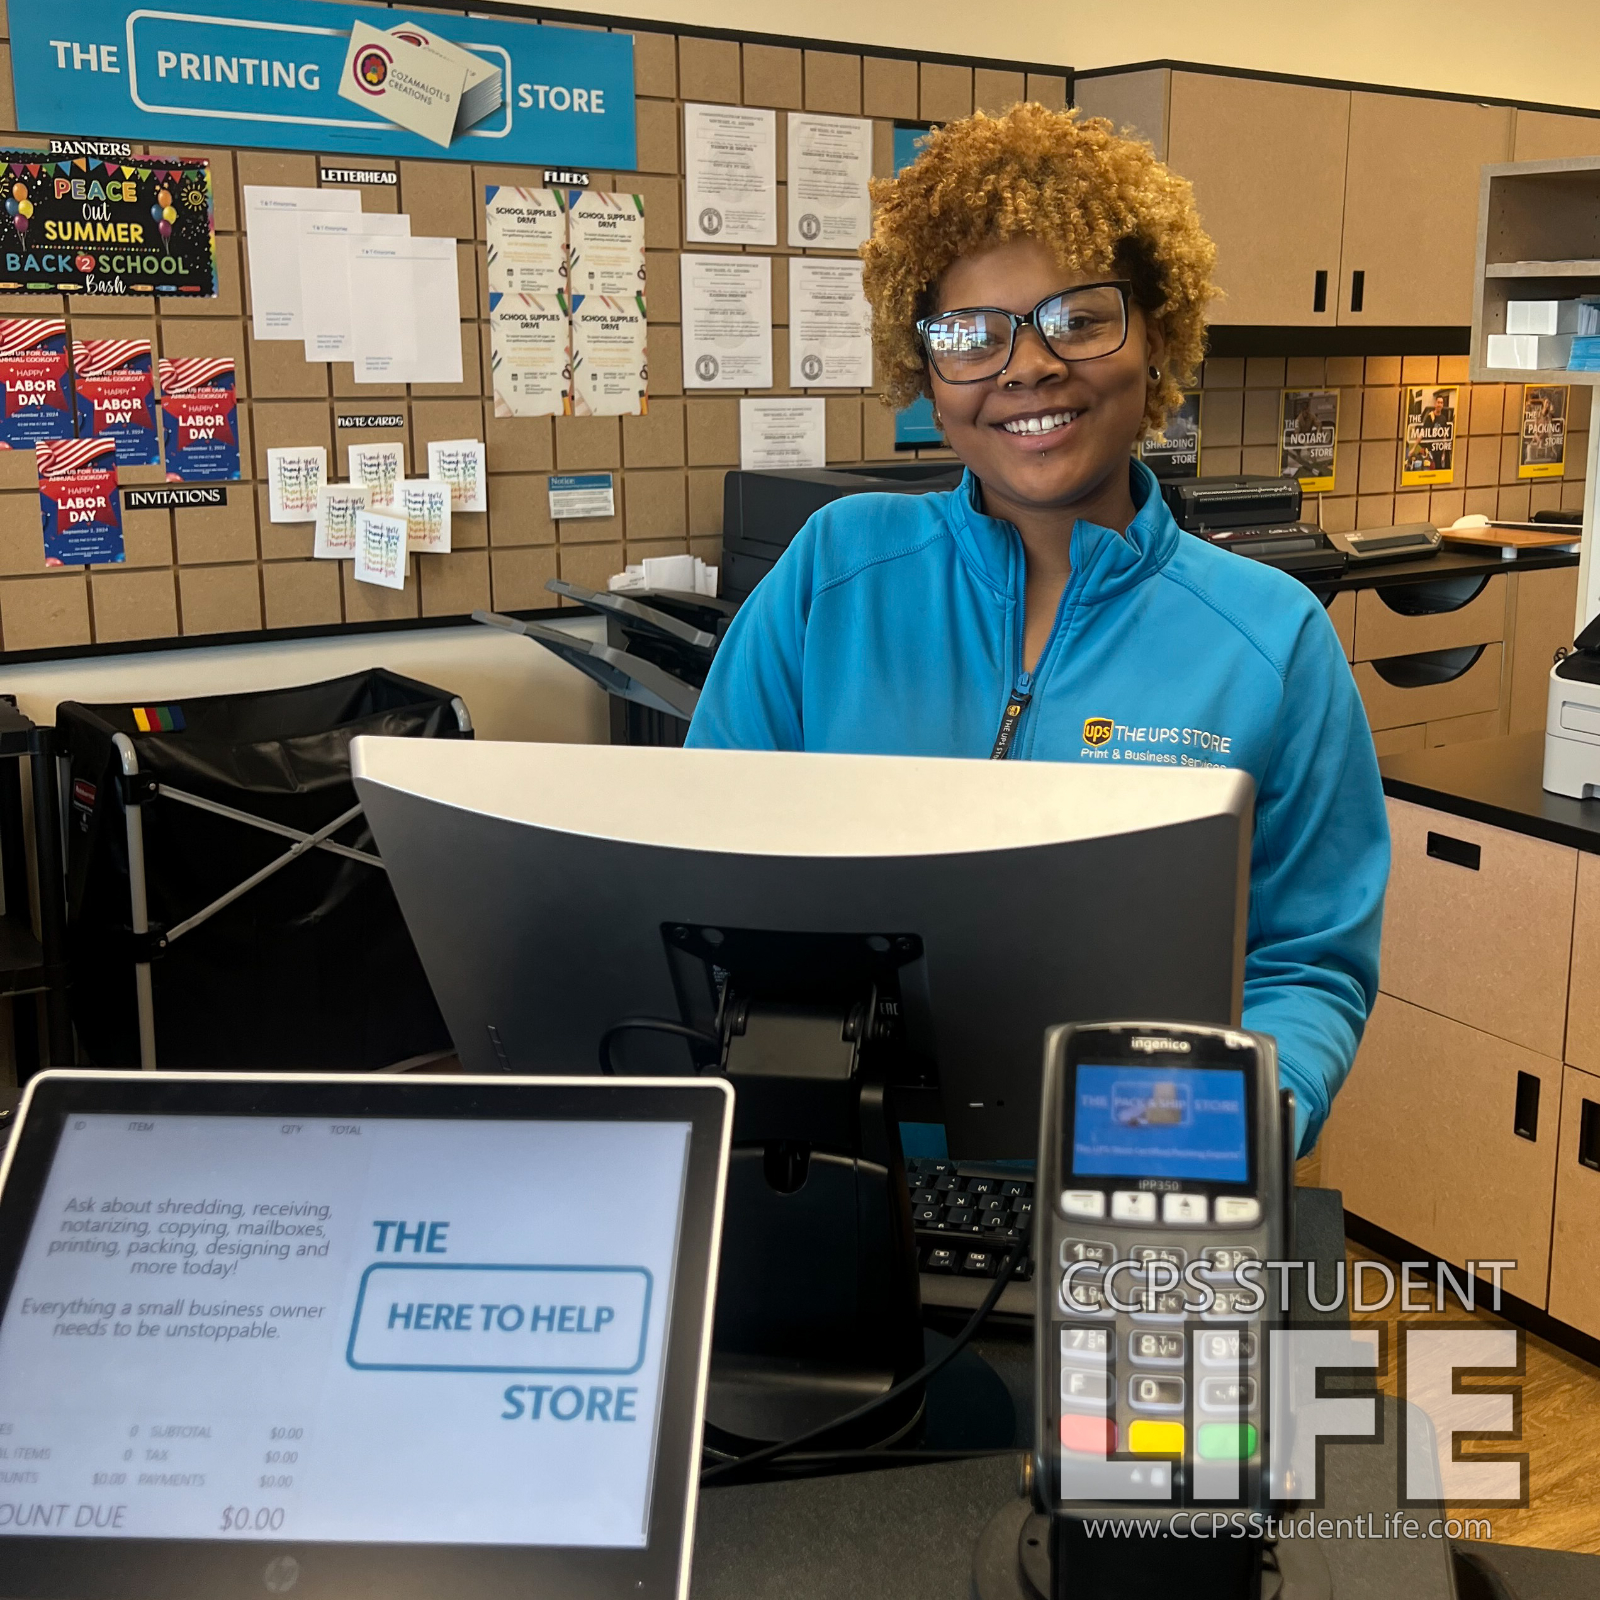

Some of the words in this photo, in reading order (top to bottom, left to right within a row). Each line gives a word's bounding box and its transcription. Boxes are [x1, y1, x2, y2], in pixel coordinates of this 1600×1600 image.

[49, 40, 120, 73] THE
[157, 50, 320, 91] PRINTING
[517, 83, 606, 114] STORE
[387, 78, 433, 106] CREATIONS
[391, 69, 451, 103] COZAMALOTL'S
[51, 140, 132, 156] BANNERS
[321, 169, 397, 185] LETTERHEAD
[544, 170, 590, 186] FLIERS
[54, 178, 138, 203] PEACE
[495, 207, 526, 216] SCHOOL
[526, 209, 557, 218] SUPPLIES
[578, 212, 608, 221] SCHOOL
[608, 213, 636, 222] SUPPLIES
[516, 216, 537, 225] DRIVE
[598, 220, 617, 229] DRIVE
[44, 220, 145, 244] SUMMER
[6, 253, 74, 273] BACK
[81, 257, 91, 271] 2
[99, 255, 190, 275] SCHOOL
[85, 273, 127, 295] Bash
[499, 314, 529, 322] SCHOOL
[530, 314, 560, 322] SUPPLIES
[581, 315, 610, 324] SCHOOL
[611, 316, 638, 324] SUPPLIES
[520, 321, 540, 330] DRIVE
[601, 322, 620, 331] DRIVE
[17, 369, 44, 377] HAPPY
[5, 380, 57, 392] LABOR
[104, 388, 130, 396] HAPPY
[18, 394, 47, 406] DAY
[94, 398, 142, 410] LABOR
[188, 405, 214, 413] HAPPY
[1525, 411, 1537, 420] THE
[105, 412, 132, 424] DAY
[178, 414, 224, 427] LABOR
[338, 416, 368, 427] NOTE
[368, 416, 404, 427] CARDS
[1284, 420, 1299, 429] THE
[1408, 414, 1422, 423] THE
[189, 428, 216, 440] DAY
[1410, 426, 1450, 439] MAILBOX
[1528, 423, 1560, 434] PACKING
[1146, 438, 1194, 450] SHREDDING
[1290, 432, 1328, 446] NOTARY
[1544, 436, 1564, 446] STORE
[1310, 448, 1333, 458] STORE
[1431, 442, 1452, 452] STORE
[1172, 454, 1197, 465] STORE
[551, 477, 576, 485] Notice
[68, 487, 94, 495] HAPPY
[130, 488, 221, 506] INVITATIONS
[58, 496, 107, 510] LABOR
[70, 510, 97, 523] DAY
[1003, 718, 1013, 732] THE
[998, 733, 1008, 746] UPS
[1086, 724, 1110, 742] ups
[1115, 725, 1147, 742] THE
[1148, 728, 1180, 744] UPS
[1182, 728, 1232, 754] STORE
[1080, 748, 1109, 759] Print
[1112, 748, 1121, 760] &
[1124, 749, 1177, 764] Business
[1131, 1036, 1189, 1054] ingenico
[74, 1122, 86, 1131] ID
[128, 1122, 154, 1132] ITEM
[281, 1125, 304, 1135] QTY
[330, 1125, 363, 1135] TOTAL
[64, 1197, 95, 1213] Ask
[101, 1198, 152, 1214] about
[157, 1198, 246, 1220] shredding,
[253, 1200, 333, 1220] receiving,
[60, 1218, 151, 1237] notarizing,
[159, 1220, 230, 1239] copying,
[238, 1220, 327, 1239] mailboxes,
[372, 1220, 450, 1254] THE
[47, 1238, 121, 1258] printing,
[127, 1238, 199, 1258] packing,
[206, 1239, 291, 1259] designing
[296, 1241, 330, 1257] and
[1073, 1244, 1086, 1261] 1
[1215, 1250, 1229, 1269] 3
[130, 1261, 177, 1276] more
[183, 1260, 239, 1280] today!
[20, 1297, 116, 1319] Everything
[121, 1304, 133, 1316] a
[138, 1299, 184, 1317] small
[189, 1300, 264, 1318] business
[269, 1305, 326, 1318] owner
[388, 1302, 474, 1330] HERE
[480, 1304, 524, 1332] TO
[530, 1304, 615, 1332] HELP
[54, 1320, 108, 1337] needs
[113, 1322, 132, 1338] to
[137, 1322, 160, 1338] be
[166, 1322, 280, 1343] unstoppable.
[1140, 1335, 1156, 1354] 8
[1211, 1336, 1227, 1356] 9
[501, 1384, 638, 1422] STORE
[150, 1425, 213, 1439] SUBTOTAL
[270, 1426, 304, 1441] $0.00
[14, 1448, 51, 1460] ITEMS
[145, 1449, 170, 1462] TAX
[265, 1450, 299, 1464] $0.00
[91, 1472, 126, 1486] $0.00
[138, 1472, 207, 1488] PAYMENTS
[259, 1474, 294, 1489] $0.00
[74, 1504, 128, 1528] DUE
[221, 1505, 286, 1532] $0.00
